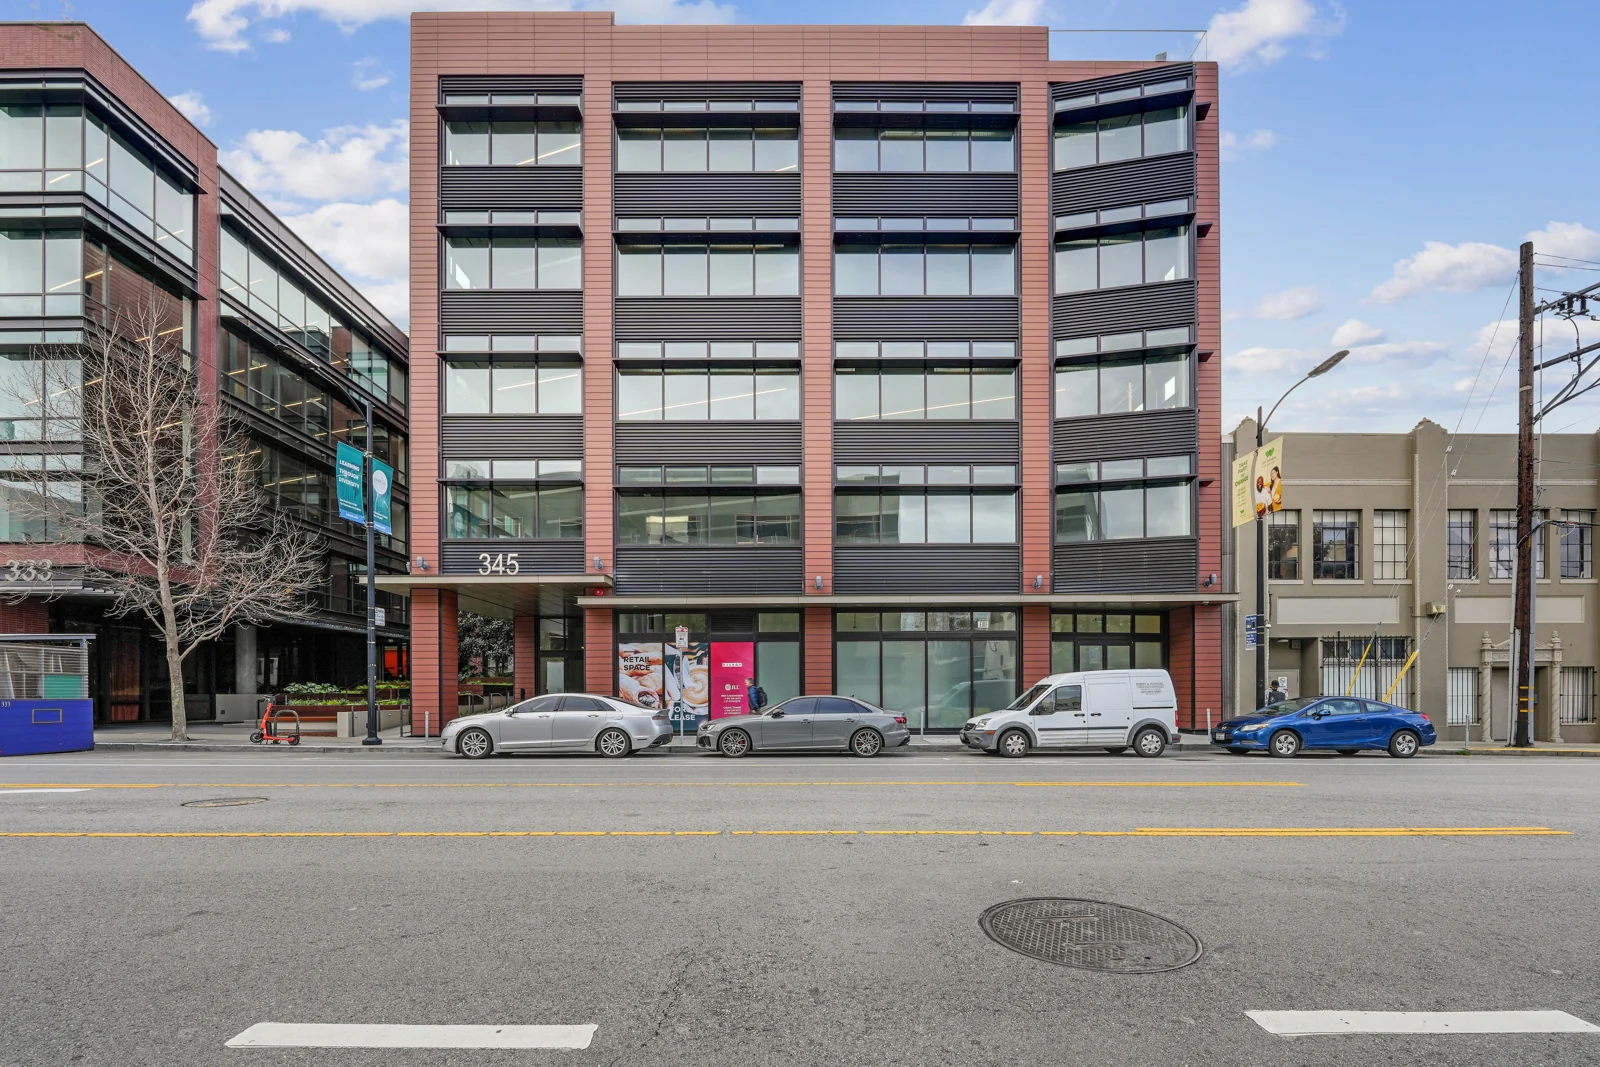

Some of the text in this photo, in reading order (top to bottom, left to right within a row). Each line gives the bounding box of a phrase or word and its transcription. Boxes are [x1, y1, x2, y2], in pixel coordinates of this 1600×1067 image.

[340, 459, 359, 471] LEARNING
[339, 467, 358, 479] THROUGH
[339, 477, 359, 488] DIVERSITY
[478, 553, 519, 575] 345
[5, 559, 53, 582] 333
